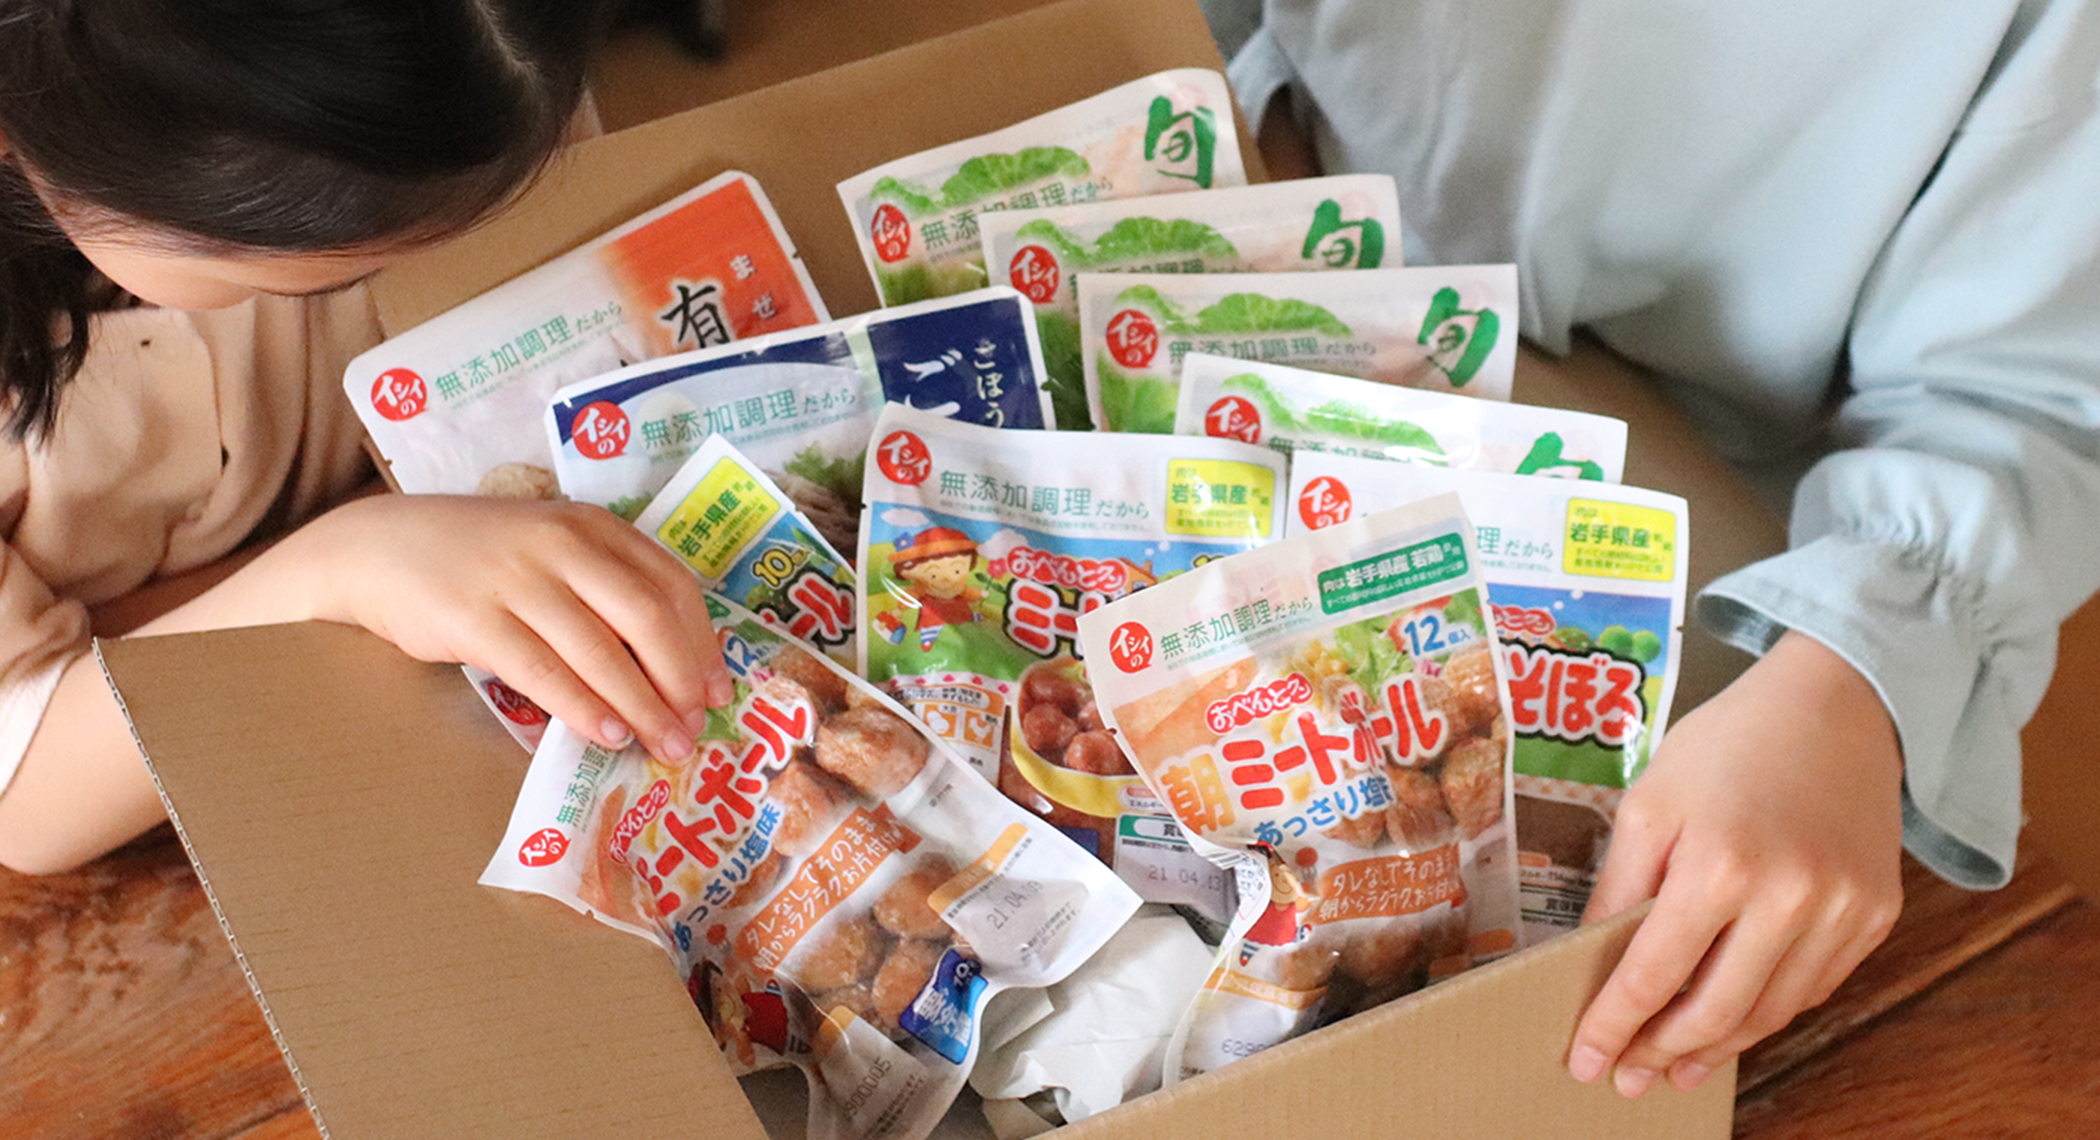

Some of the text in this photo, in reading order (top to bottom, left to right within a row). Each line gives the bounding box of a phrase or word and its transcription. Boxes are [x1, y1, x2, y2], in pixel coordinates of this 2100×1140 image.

[1145, 96, 1217, 189] 旬
[661, 285, 731, 348] 有
[1418, 287, 1499, 387] 旬
[373, 374, 426, 415] イシイの
[573, 407, 628, 454] イシイの
[1208, 399, 1259, 443] イシイ
[879, 434, 929, 480] イシイの
[940, 470, 1150, 518] 無添加調理だから
[677, 489, 742, 557] 岩手県産
[1570, 523, 1650, 549] 岩手県産
[1111, 627, 1151, 668] イシイの
[1160, 596, 1314, 661] 無添加調理だから
[522, 830, 562, 865] イシイの
